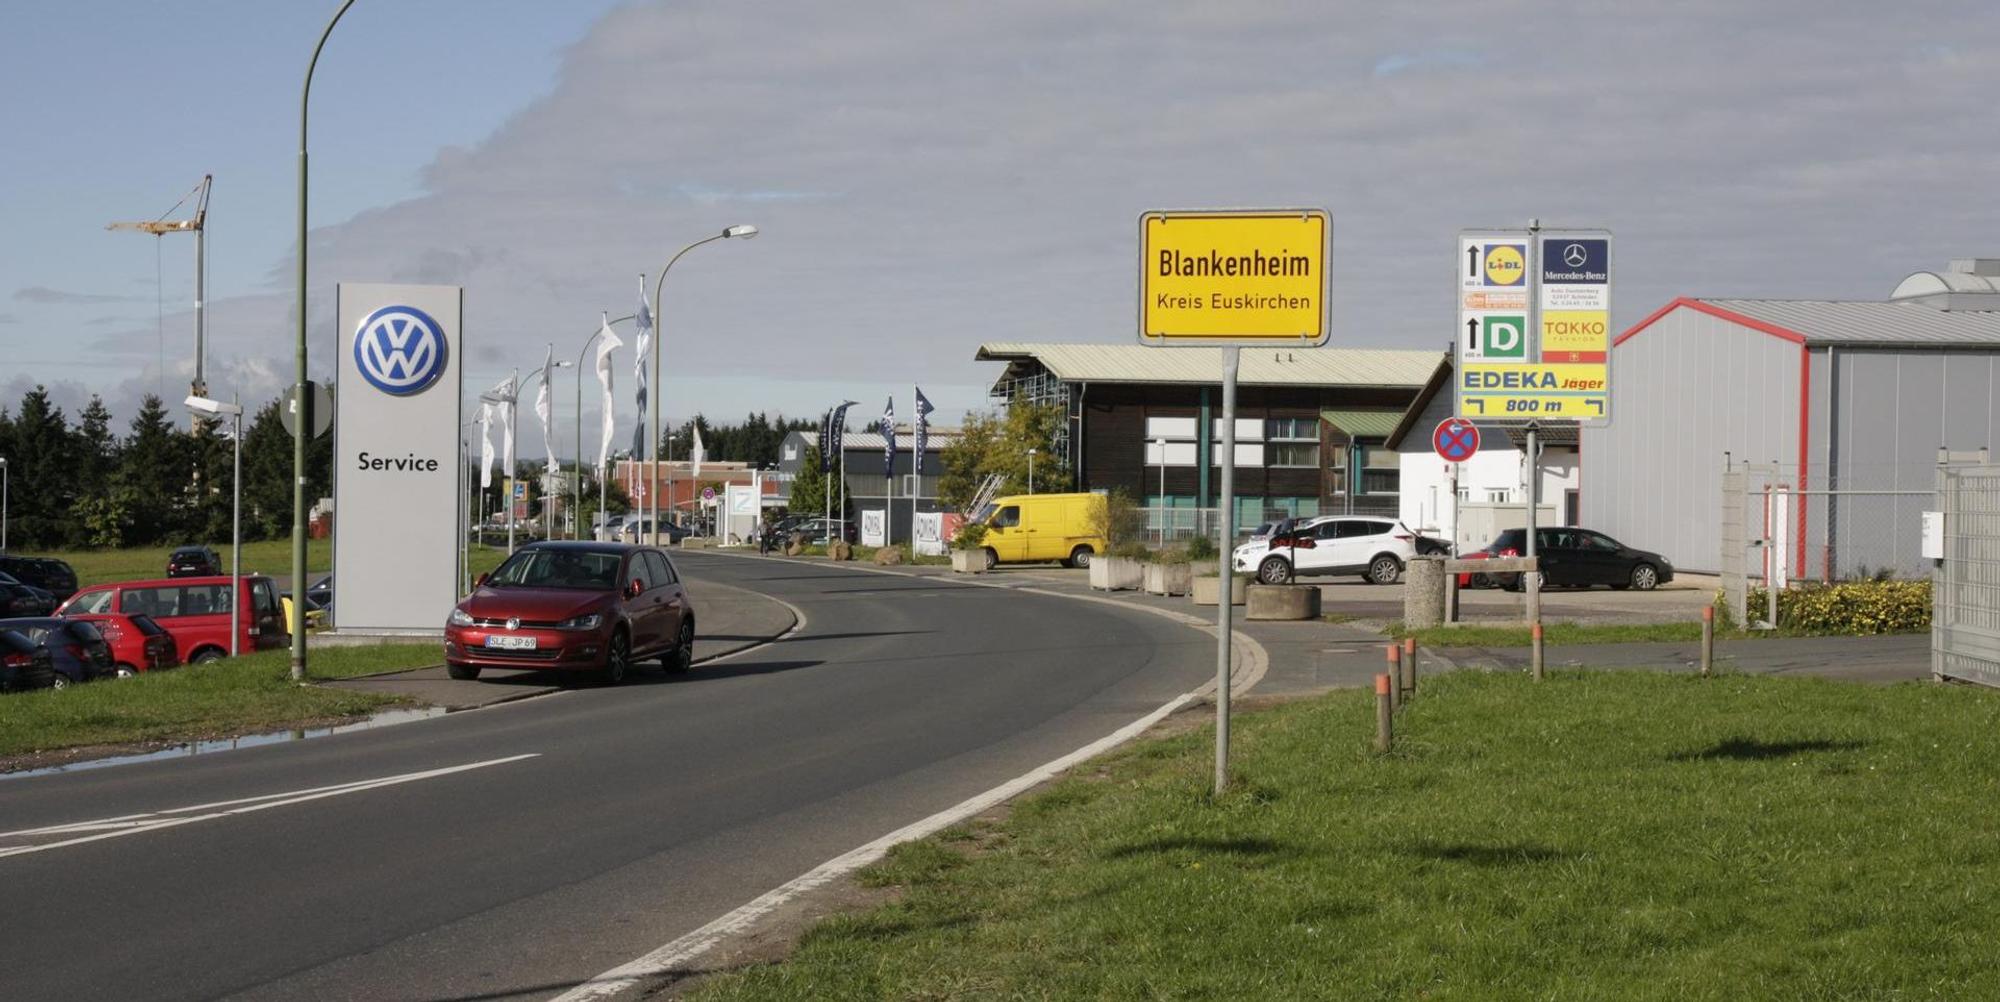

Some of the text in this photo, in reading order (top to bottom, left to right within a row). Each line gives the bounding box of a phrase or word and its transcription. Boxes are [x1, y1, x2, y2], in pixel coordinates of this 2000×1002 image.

[1159, 249, 1310, 276] Blankenheim
[1545, 272, 1606, 281] Mercedes-Benz
[1157, 293, 1311, 309] Kreis Euskirchen
[1464, 371, 1557, 389] EDEKA
[1506, 400, 1562, 412] 800 m
[358, 452, 438, 472] Service
[512, 637, 523, 648] JP
[524, 638, 536, 648] 69
